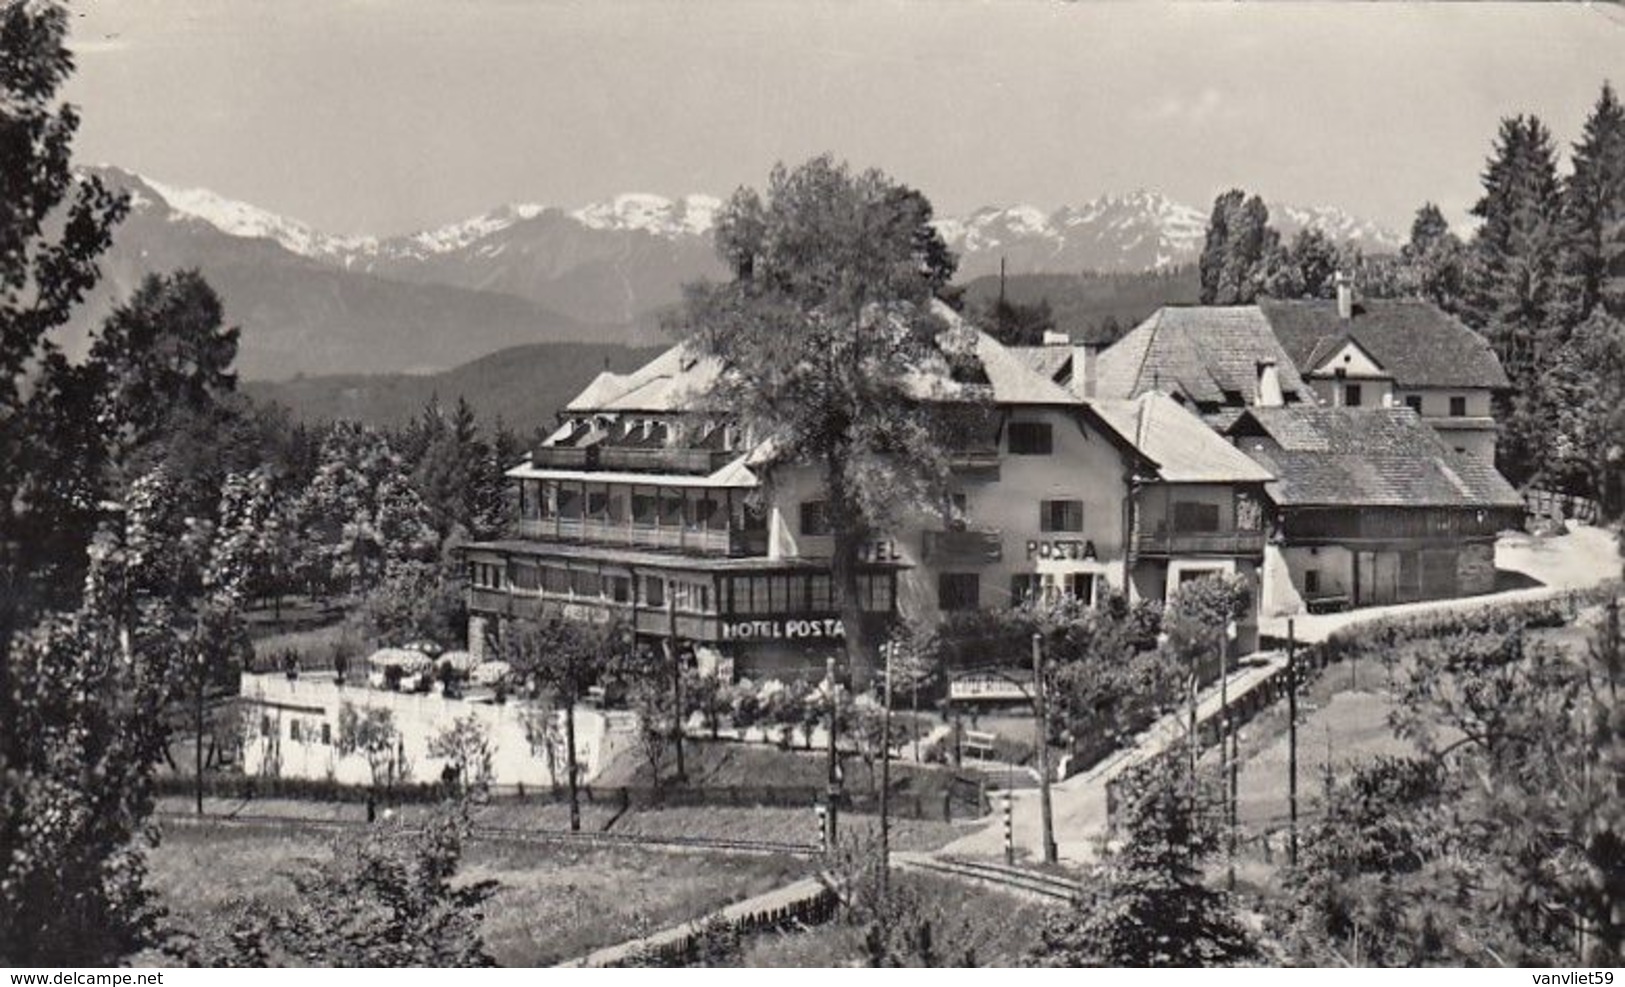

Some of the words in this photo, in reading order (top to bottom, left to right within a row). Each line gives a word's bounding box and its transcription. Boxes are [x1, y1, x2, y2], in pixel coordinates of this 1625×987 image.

[1026, 539, 1098, 561] POSTA
[722, 620, 781, 639] HOTEL
[785, 618, 847, 638] POSTA
